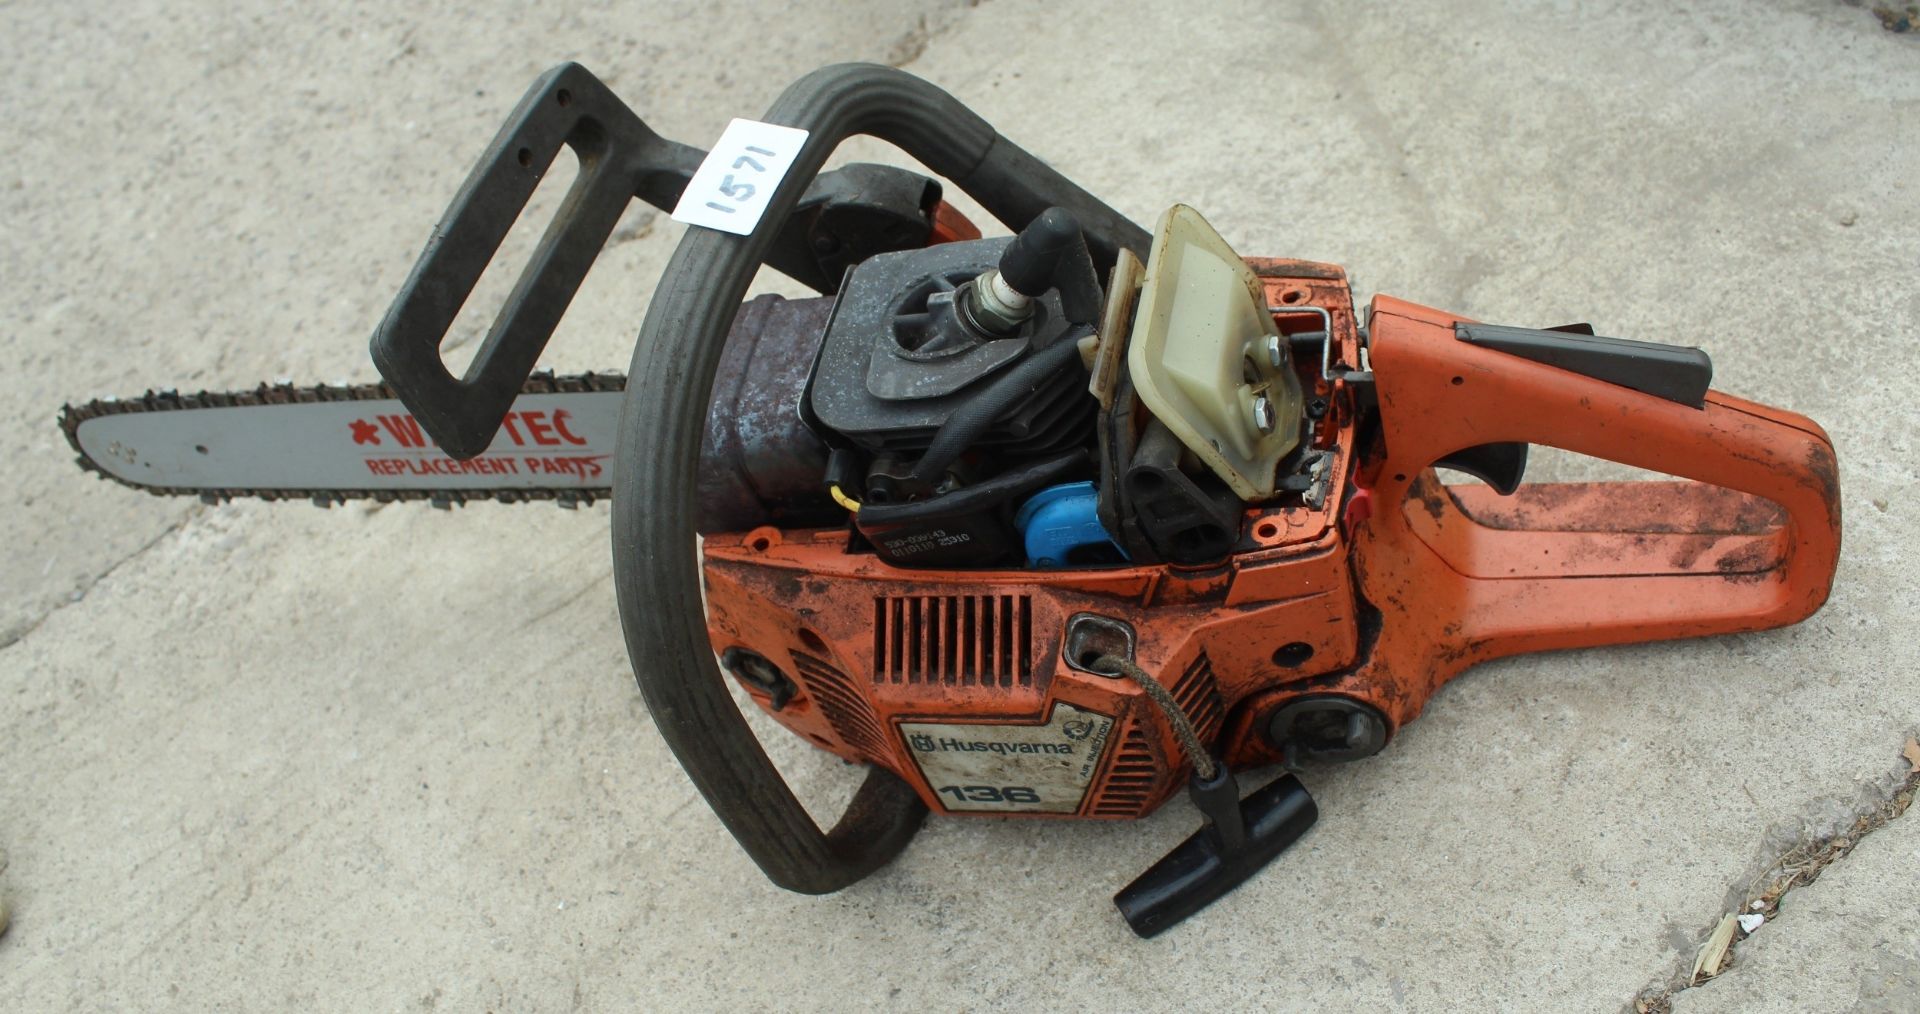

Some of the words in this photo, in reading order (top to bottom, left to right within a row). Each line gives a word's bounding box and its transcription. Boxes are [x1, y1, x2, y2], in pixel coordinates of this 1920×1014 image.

[705, 146, 776, 213] 1571
[365, 457, 518, 476] REPLACEMENT
[524, 455, 609, 481] PARTS
[939, 737, 1073, 756] Husqvarna
[1080, 764, 1091, 777] AIR
[938, 785, 1041, 803] 136
